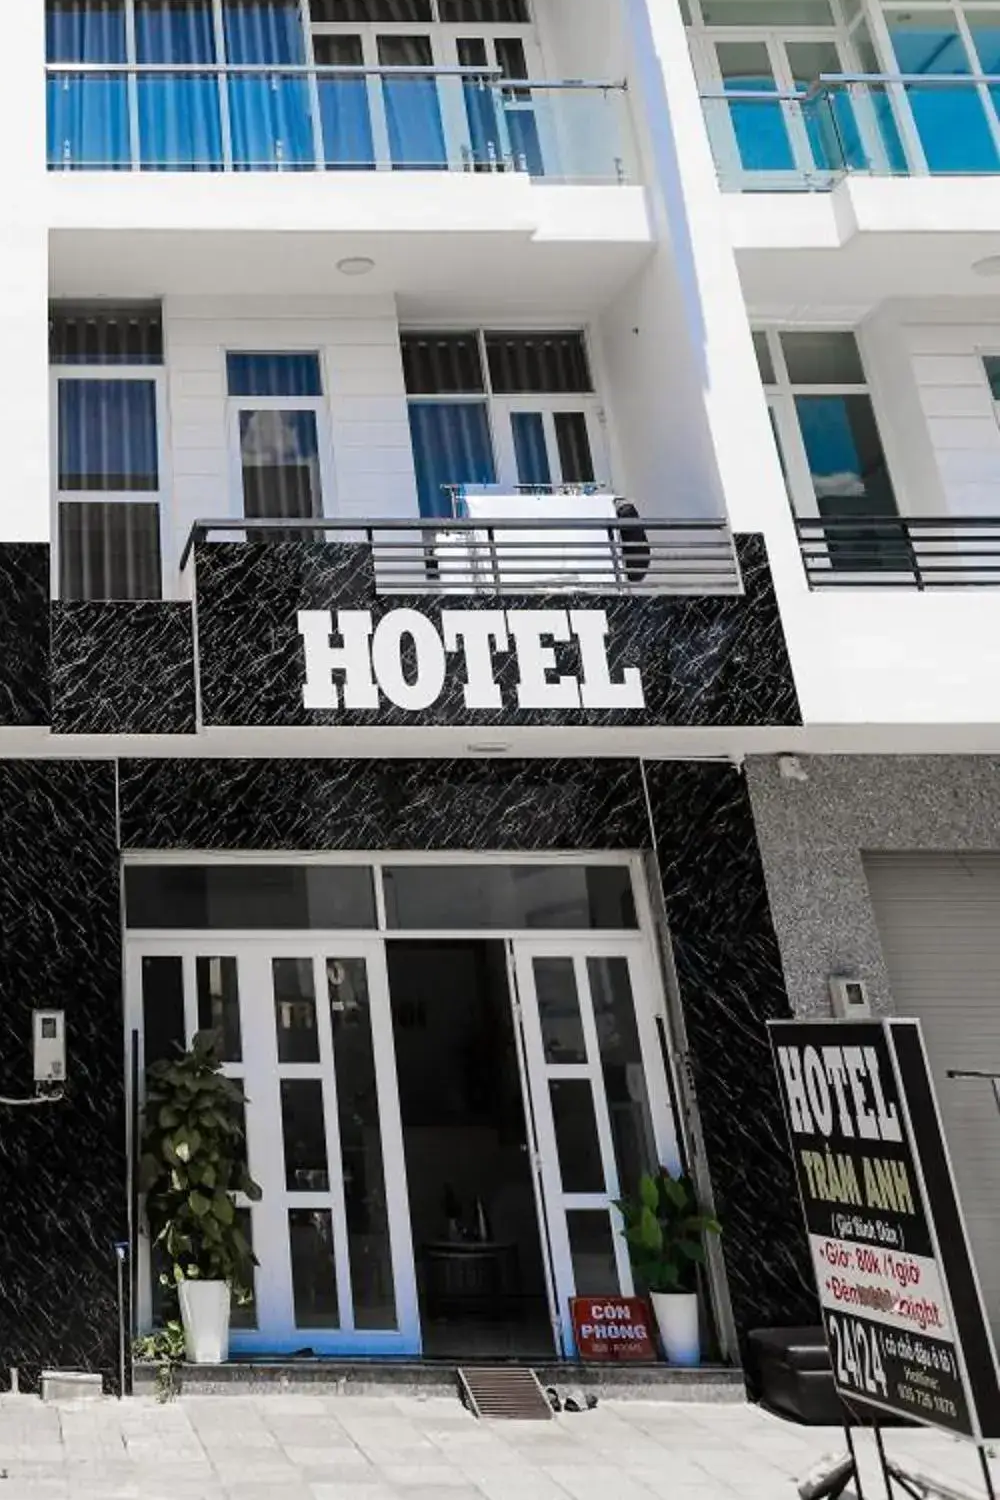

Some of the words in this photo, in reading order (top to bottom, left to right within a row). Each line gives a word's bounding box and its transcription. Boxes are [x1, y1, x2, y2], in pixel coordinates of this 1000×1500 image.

[297, 607, 646, 711] HOTEL
[777, 1044, 903, 1142] HOTEL
[861, 1156, 915, 1215] ANH
[829, 1315, 888, 1398] 24/24
